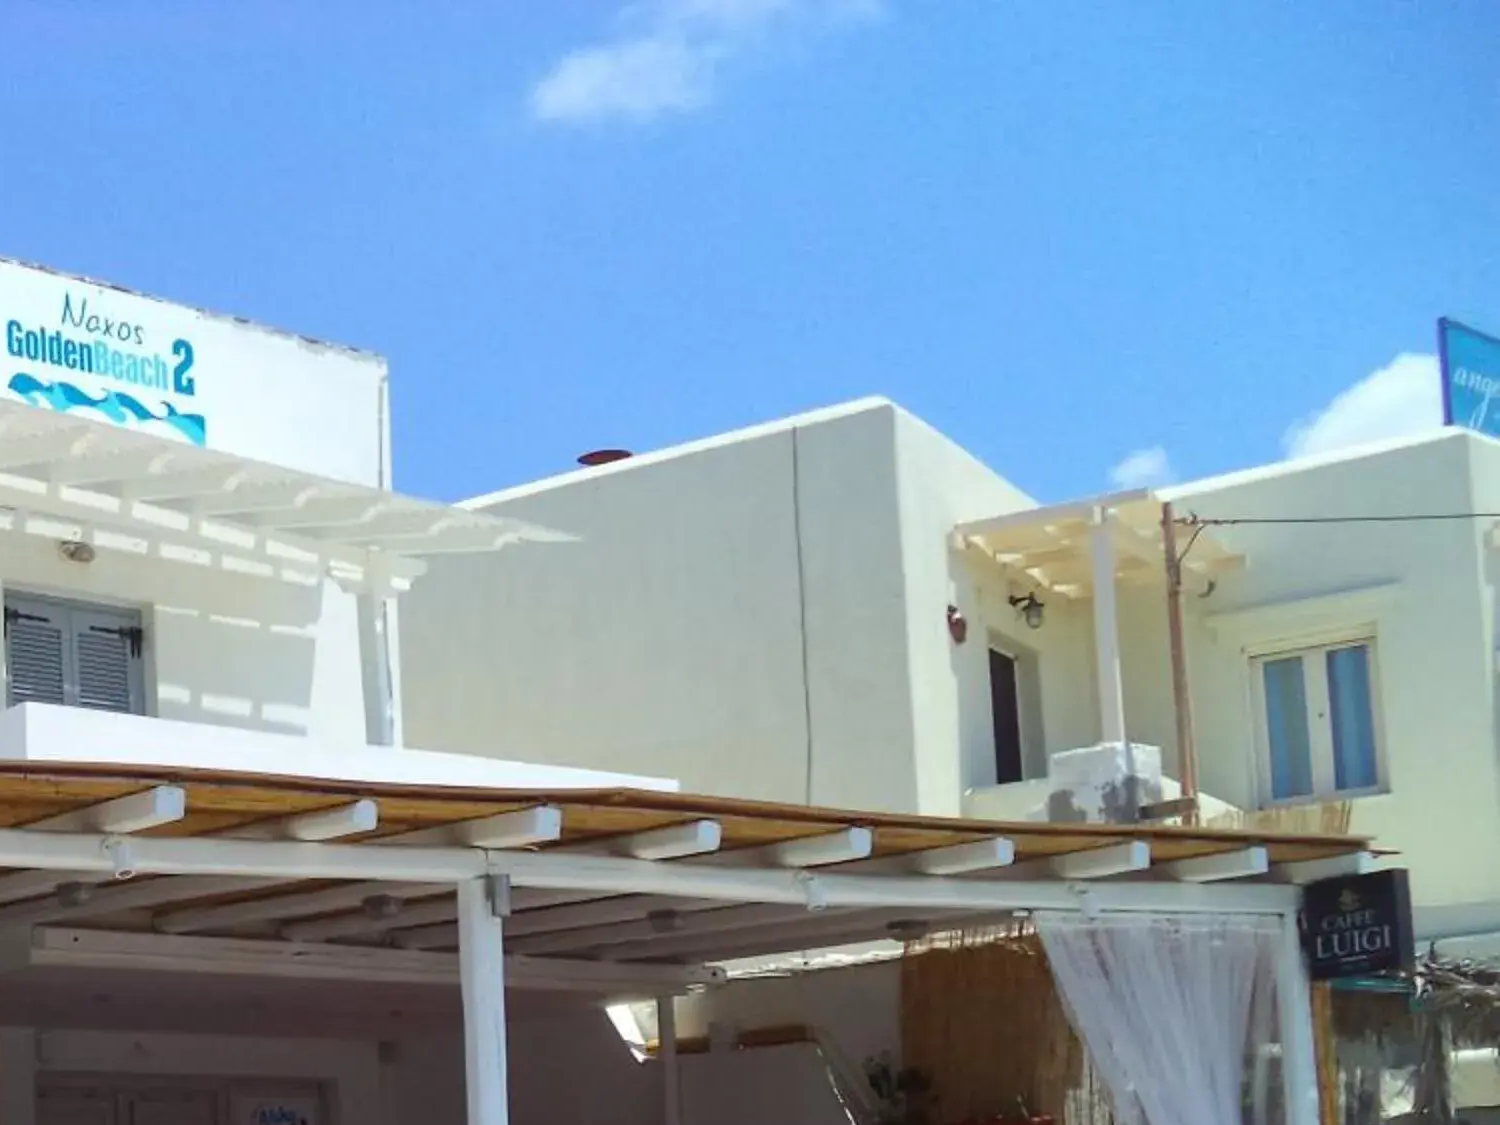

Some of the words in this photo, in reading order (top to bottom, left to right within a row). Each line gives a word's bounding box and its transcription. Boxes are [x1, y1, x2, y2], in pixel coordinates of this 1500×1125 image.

[61, 291, 144, 344] Naxos
[172, 338, 196, 396] 2
[1316, 924, 1391, 959] LUIGI
